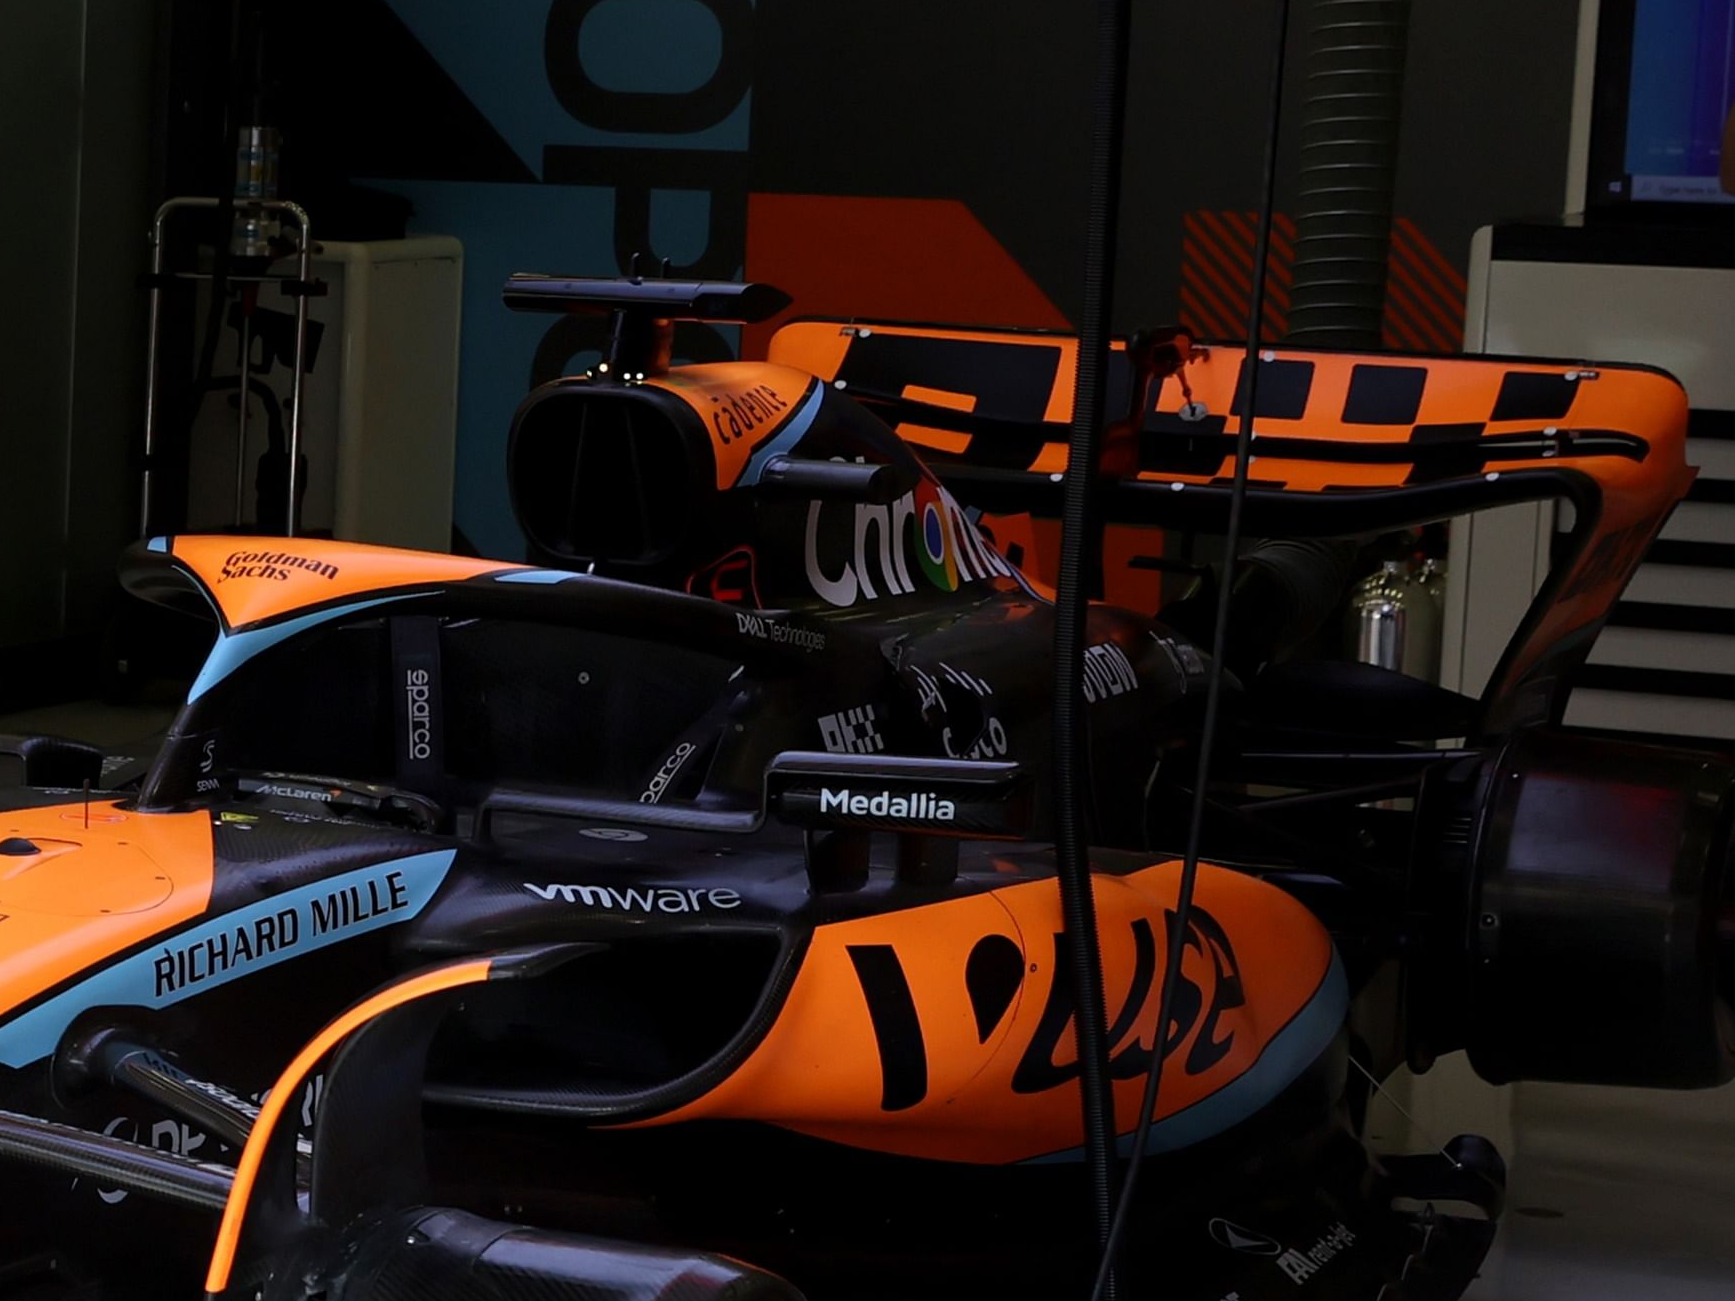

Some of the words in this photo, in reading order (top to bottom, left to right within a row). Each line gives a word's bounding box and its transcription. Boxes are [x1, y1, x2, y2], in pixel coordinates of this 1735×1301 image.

[217, 563, 291, 585] Sachs
[225, 550, 340, 580] Goldman
[638, 742, 698, 803] parco
[255, 784, 333, 803] McLaren
[820, 787, 956, 821] Medallia
[524, 882, 742, 914] vmware
[153, 907, 301, 1000] RICHARD
[310, 869, 412, 936] MILLE
[1275, 1246, 1321, 1286] FAI
